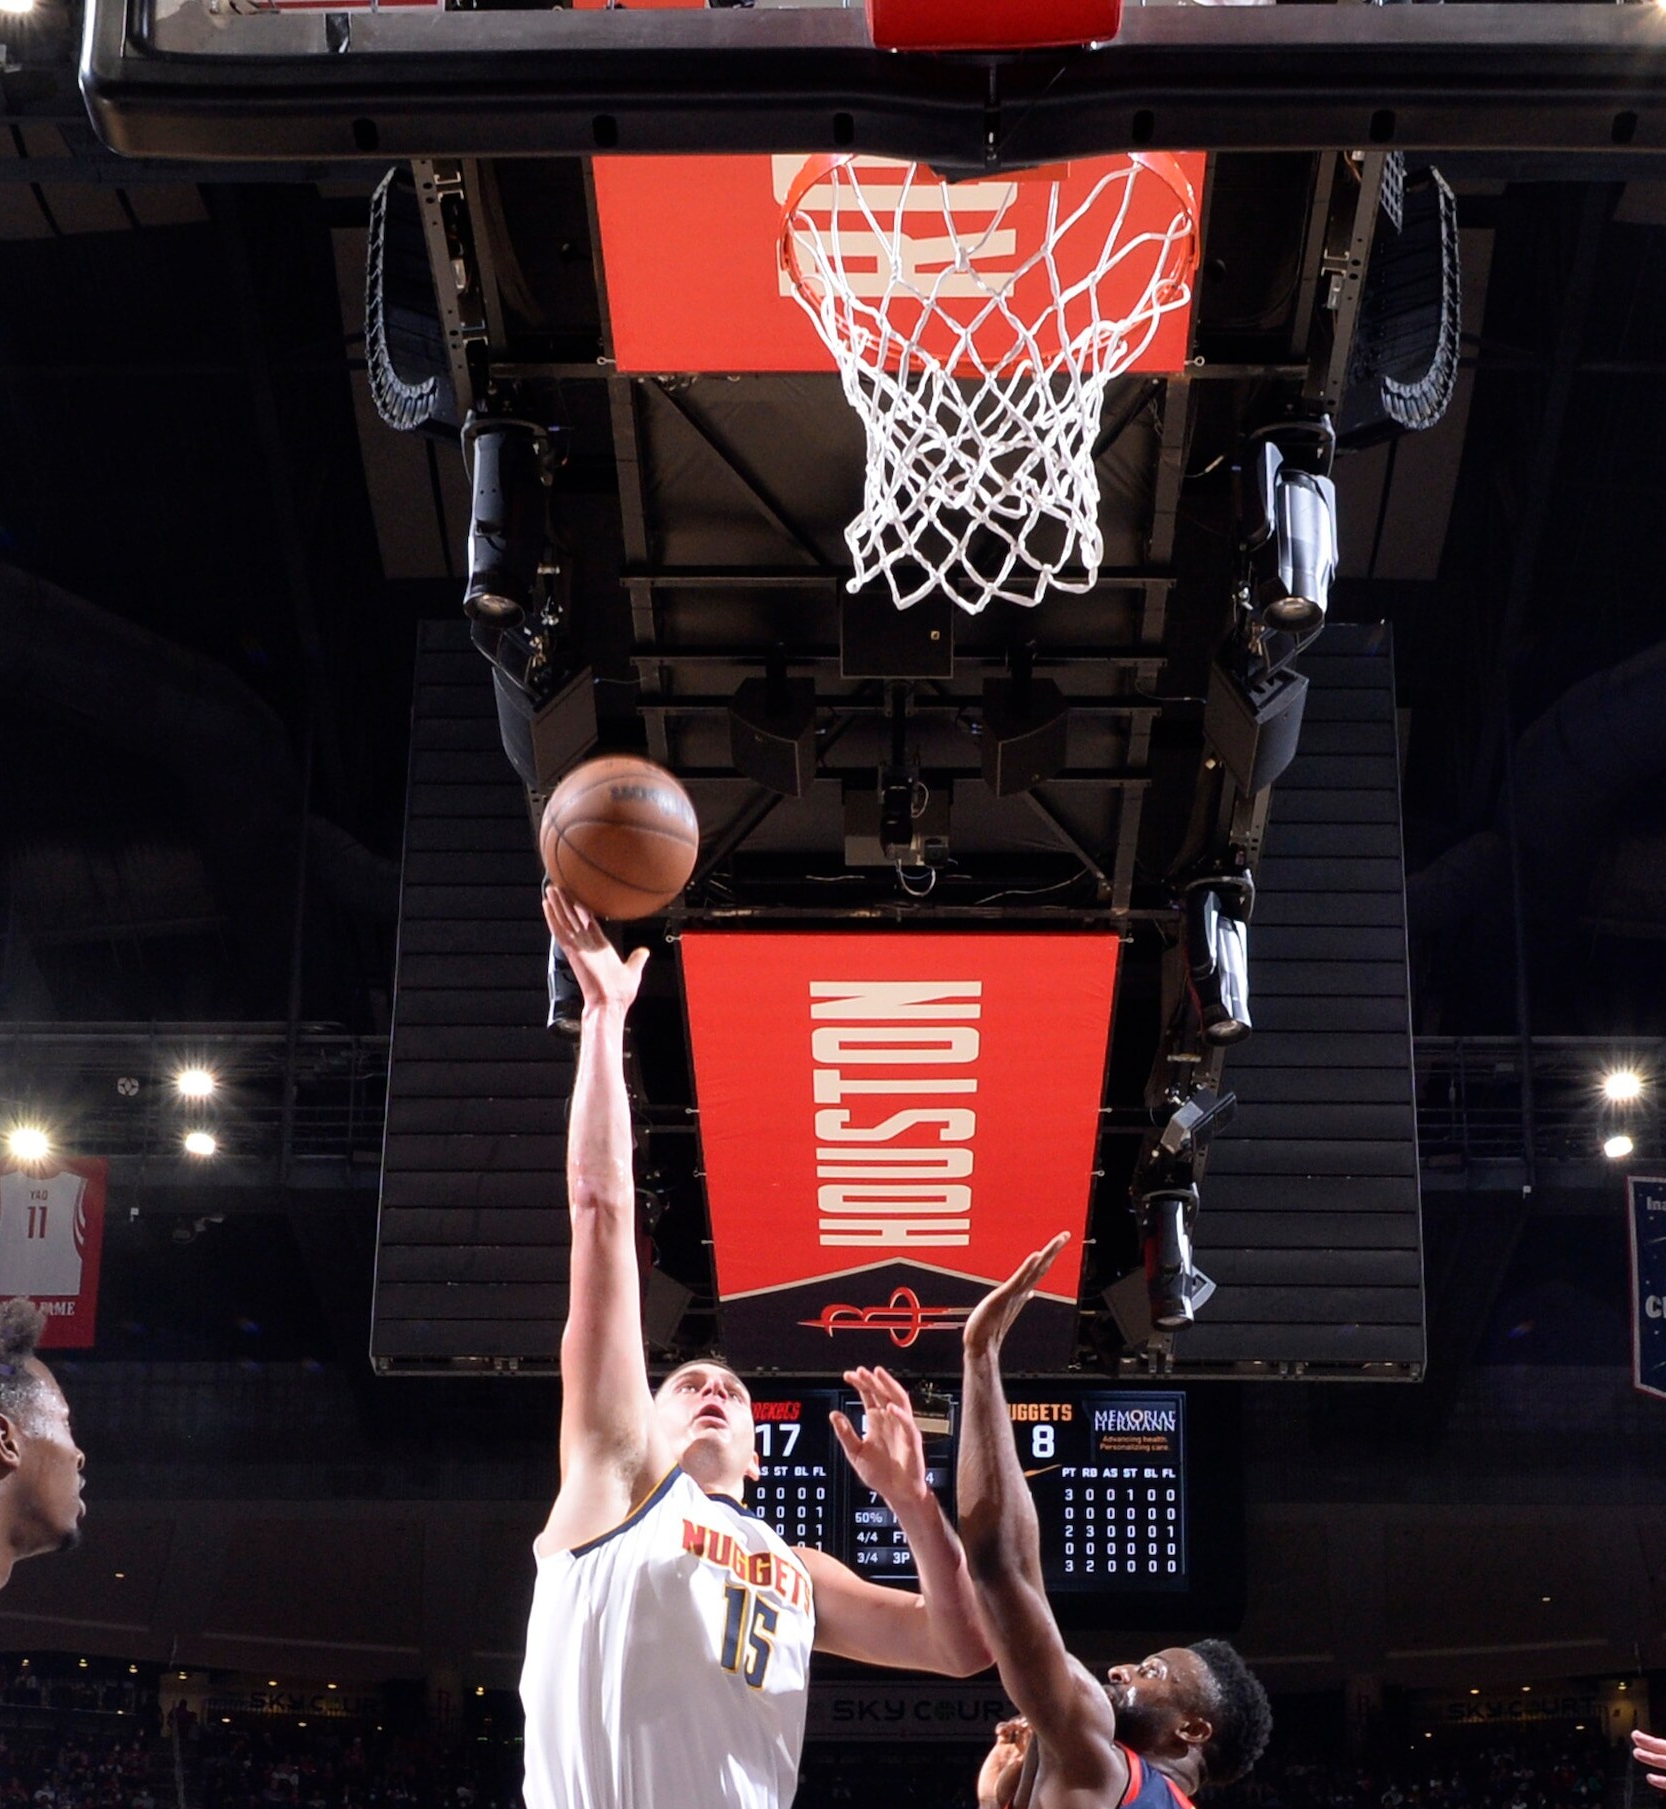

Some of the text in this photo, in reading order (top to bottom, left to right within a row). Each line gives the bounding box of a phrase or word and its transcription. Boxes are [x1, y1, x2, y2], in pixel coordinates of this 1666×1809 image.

[810, 980, 982, 1247] HOUSTON
[28, 1207, 46, 1238] 11
[1008, 1403, 1072, 1421] UGGETS
[1095, 1409, 1176, 1421] MEMORIAL
[1095, 1420, 1176, 1432] HERMANN
[1032, 1425, 1054, 1458] 8
[774, 1466, 788, 1476] ST
[794, 1466, 809, 1476] BL
[813, 1466, 826, 1476] FL
[1062, 1468, 1176, 1478] PT RB AS ST BL FL
[1065, 1489, 1175, 1501] 3 0 0 1 0 0
[757, 1507, 823, 1518] 0 0 0 1
[855, 1514, 882, 1524] 50%
[776, 1524, 823, 1536] 0 0 1
[1065, 1526, 1173, 1537] 2 3 0 0 0 1
[857, 1532, 878, 1543] 4/4
[857, 1552, 910, 1564] 3/4 3P
[1065, 1560, 1177, 1572] 3 2 0 0 0 0
[721, 1582, 779, 1690] 15
[833, 1700, 904, 1721] SKY
